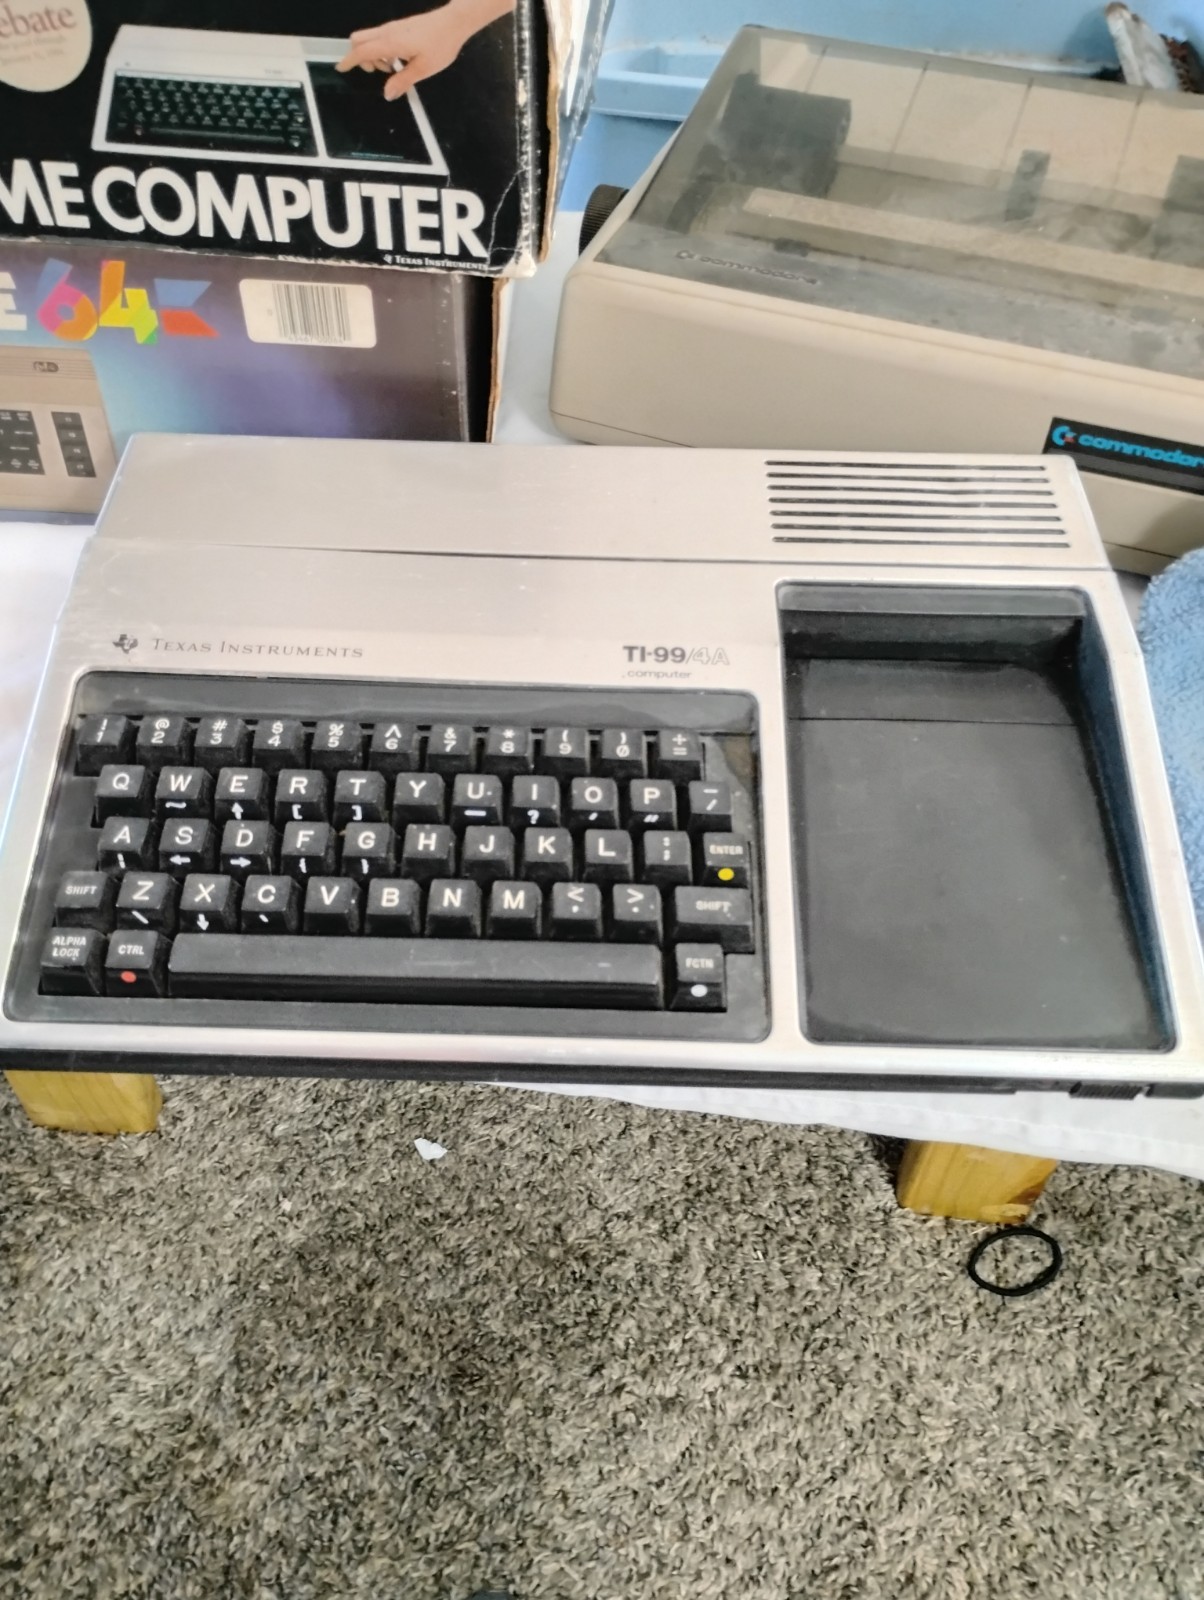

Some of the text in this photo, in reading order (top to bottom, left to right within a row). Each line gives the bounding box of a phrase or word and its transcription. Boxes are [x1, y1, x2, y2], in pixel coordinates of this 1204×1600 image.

[92, 166, 489, 258] COMPUTER
[36, 258, 158, 344] 64
[152, 638, 364, 658] TEXAS INSTRUMENTS
[622, 645, 730, 665] TI-99/4A
[627, 670, 692, 679] computer
[155, 719, 169, 730] @
[213, 720, 227, 731] #
[272, 721, 283, 735] $
[329, 724, 344, 737] %
[151, 731, 165, 743] 2
[210, 733, 222, 744] 3
[268, 734, 280, 746] 4
[328, 736, 339, 747] 5
[445, 727, 456, 740] &
[386, 738, 398, 749] 6
[444, 741, 456, 752] 7
[501, 741, 514, 753] 8
[560, 742, 572, 754] 9
[112, 773, 129, 790] Q
[170, 774, 192, 791] W
[230, 775, 248, 792] E
[289, 777, 308, 794] R
[349, 778, 366, 795] T
[409, 780, 426, 797] Y
[468, 782, 484, 799] U
[585, 786, 602, 803] O
[644, 787, 660, 804] P
[528, 810, 539, 824] ?
[113, 826, 130, 843] A
[175, 826, 193, 844] S
[236, 829, 253, 847] D
[296, 830, 314, 848] F
[358, 831, 375, 849] G
[418, 833, 436, 850] H
[479, 835, 494, 853] J
[538, 836, 555, 854] K
[598, 838, 616, 856] L
[710, 845, 743, 855] ENTER
[65, 885, 97, 894] SHIFT
[133, 881, 154, 900] Z
[194, 883, 215, 902] X
[258, 884, 276, 903] C
[321, 886, 339, 905] V
[382, 888, 399, 906] B
[443, 888, 462, 907] N
[503, 890, 524, 909] M
[696, 901, 731, 912] SHIFT
[53, 936, 86, 945] ALPHA
[53, 948, 80, 959] LOCK
[118, 945, 144, 955] CTRL
[686, 958, 713, 968] FCTN
